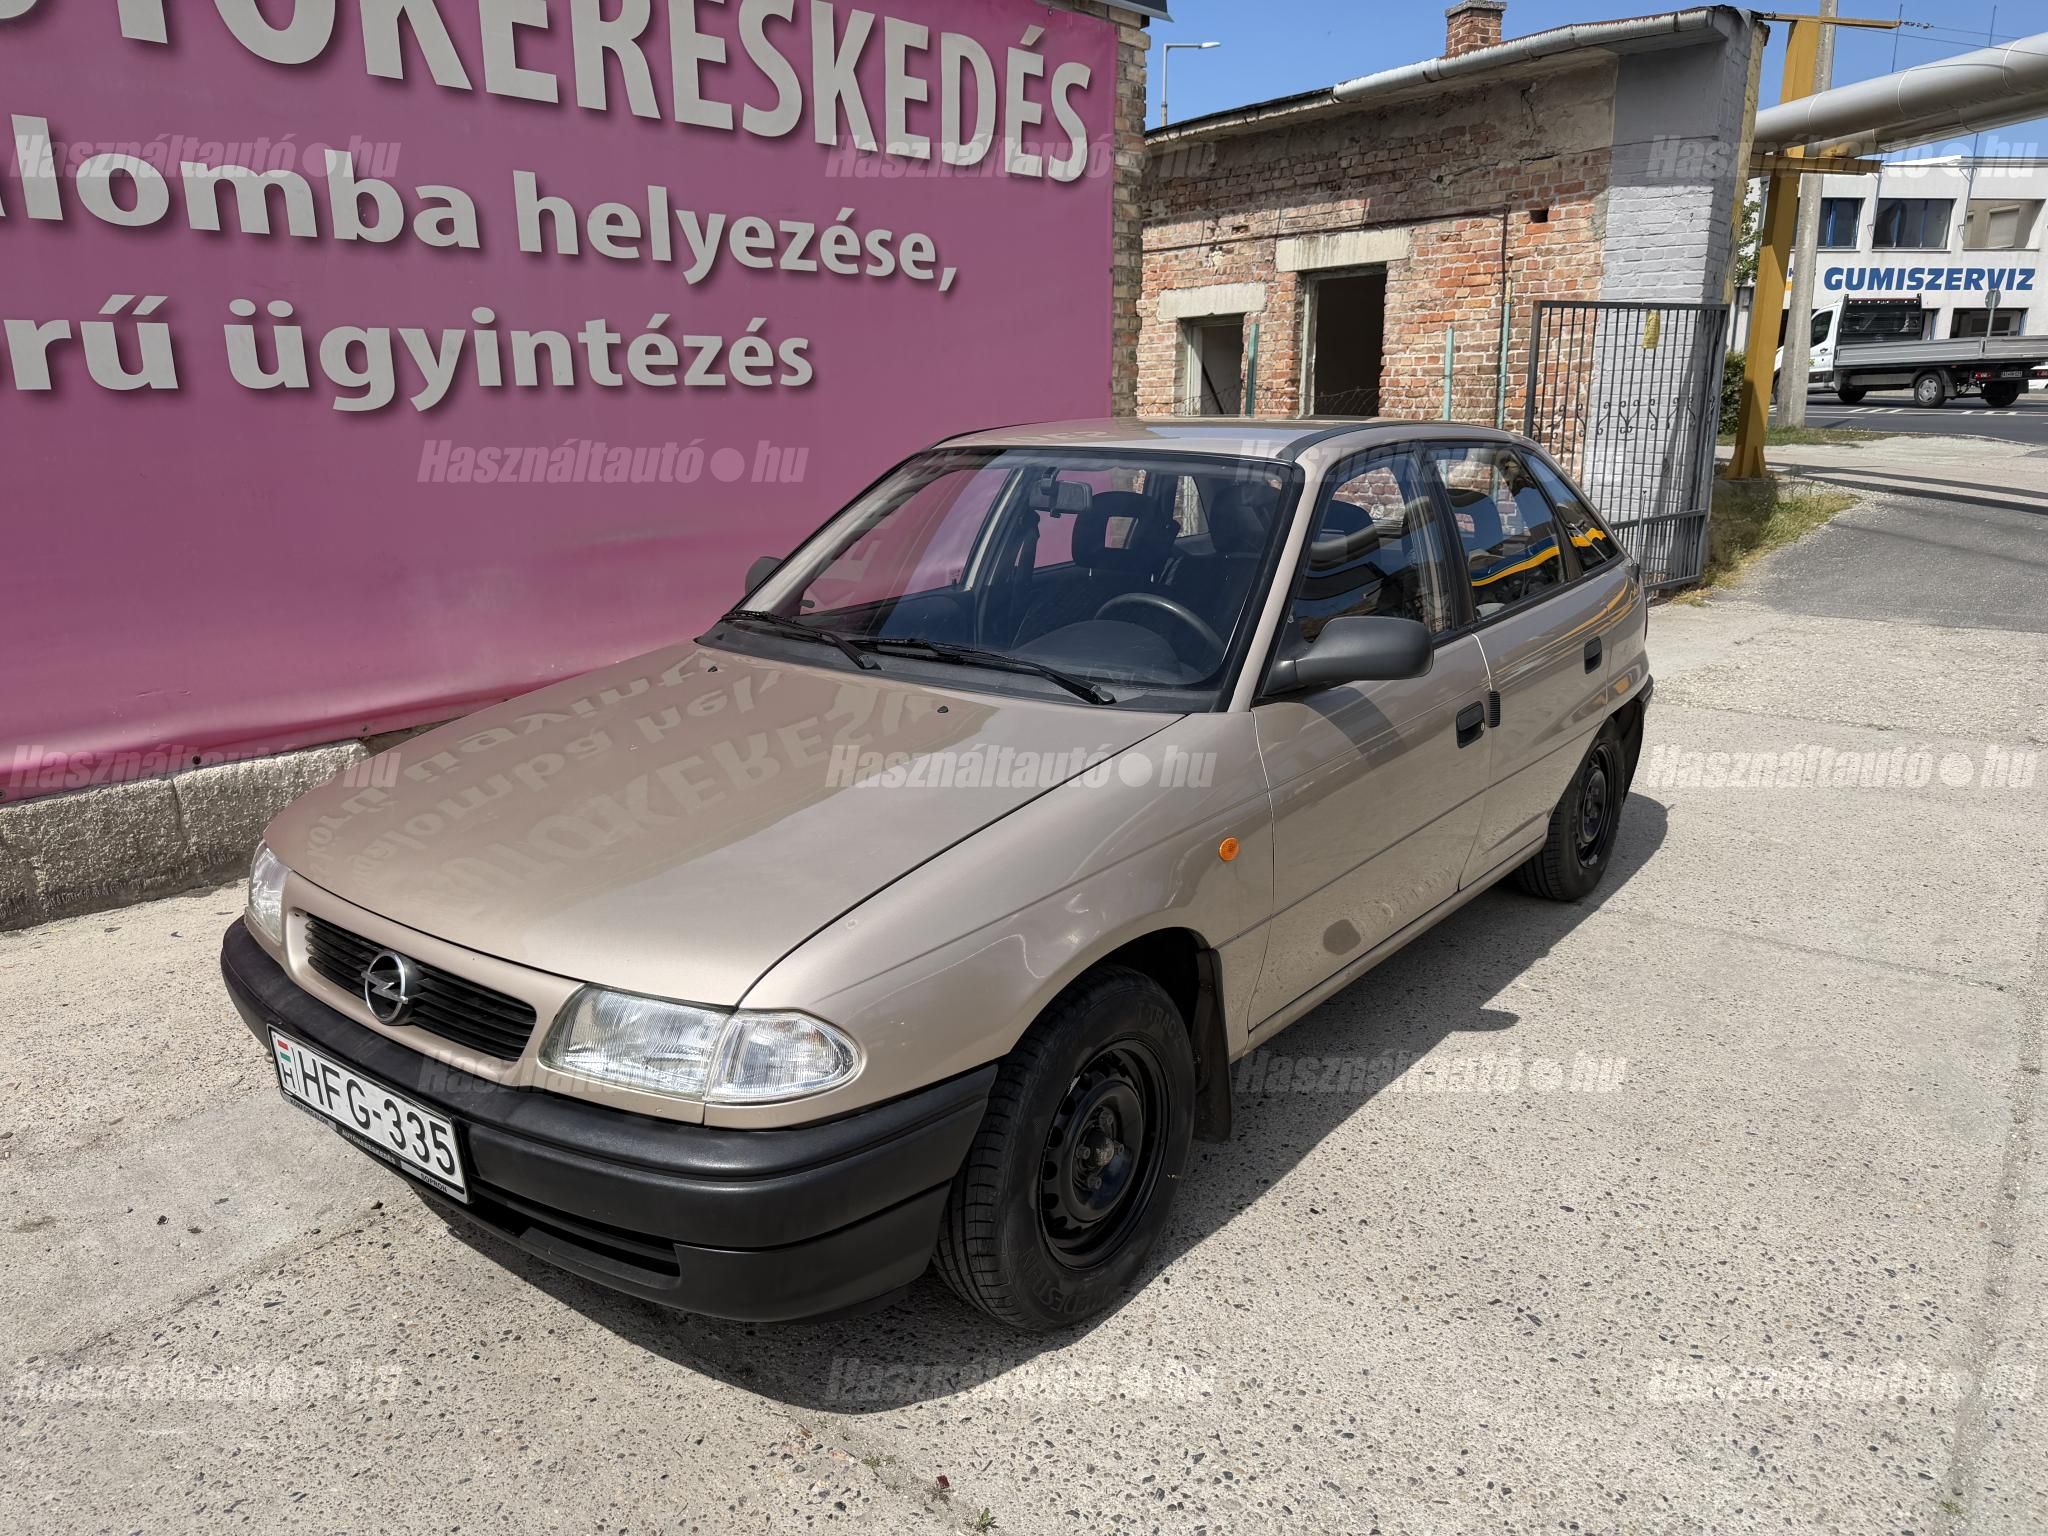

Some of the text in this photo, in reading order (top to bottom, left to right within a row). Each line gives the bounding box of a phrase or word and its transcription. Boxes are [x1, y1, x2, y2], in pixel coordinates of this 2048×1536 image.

[0, 114, 957, 291] lomba helyezése,
[1823, 266, 2036, 291] GUMISZERVIZ
[224, 298, 813, 412] ügyintézés
[281, 1050, 455, 1176] H HFG-335
[420, 1172, 449, 1194] SOPRON
